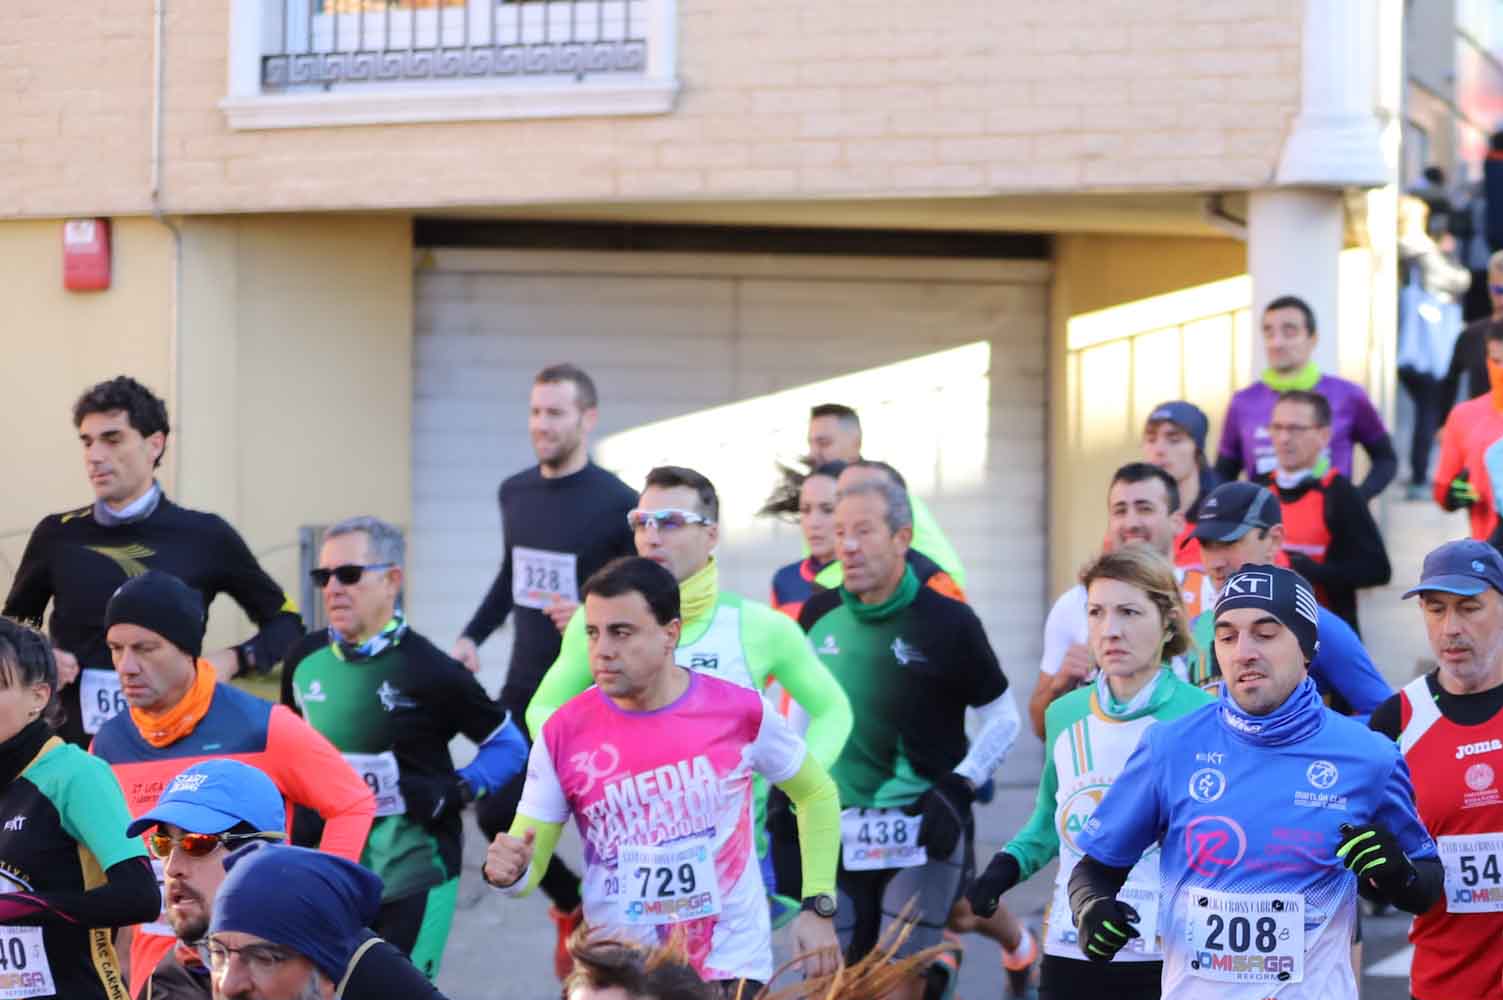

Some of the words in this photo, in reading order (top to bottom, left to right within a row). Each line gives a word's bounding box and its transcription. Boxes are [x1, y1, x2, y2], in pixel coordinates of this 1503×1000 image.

[526, 565, 561, 592] 328
[1223, 574, 1268, 597] KT
[602, 754, 720, 808] MEDIA
[857, 819, 908, 846] 438
[635, 862, 697, 898] 729
[1205, 914, 1278, 954] 208
